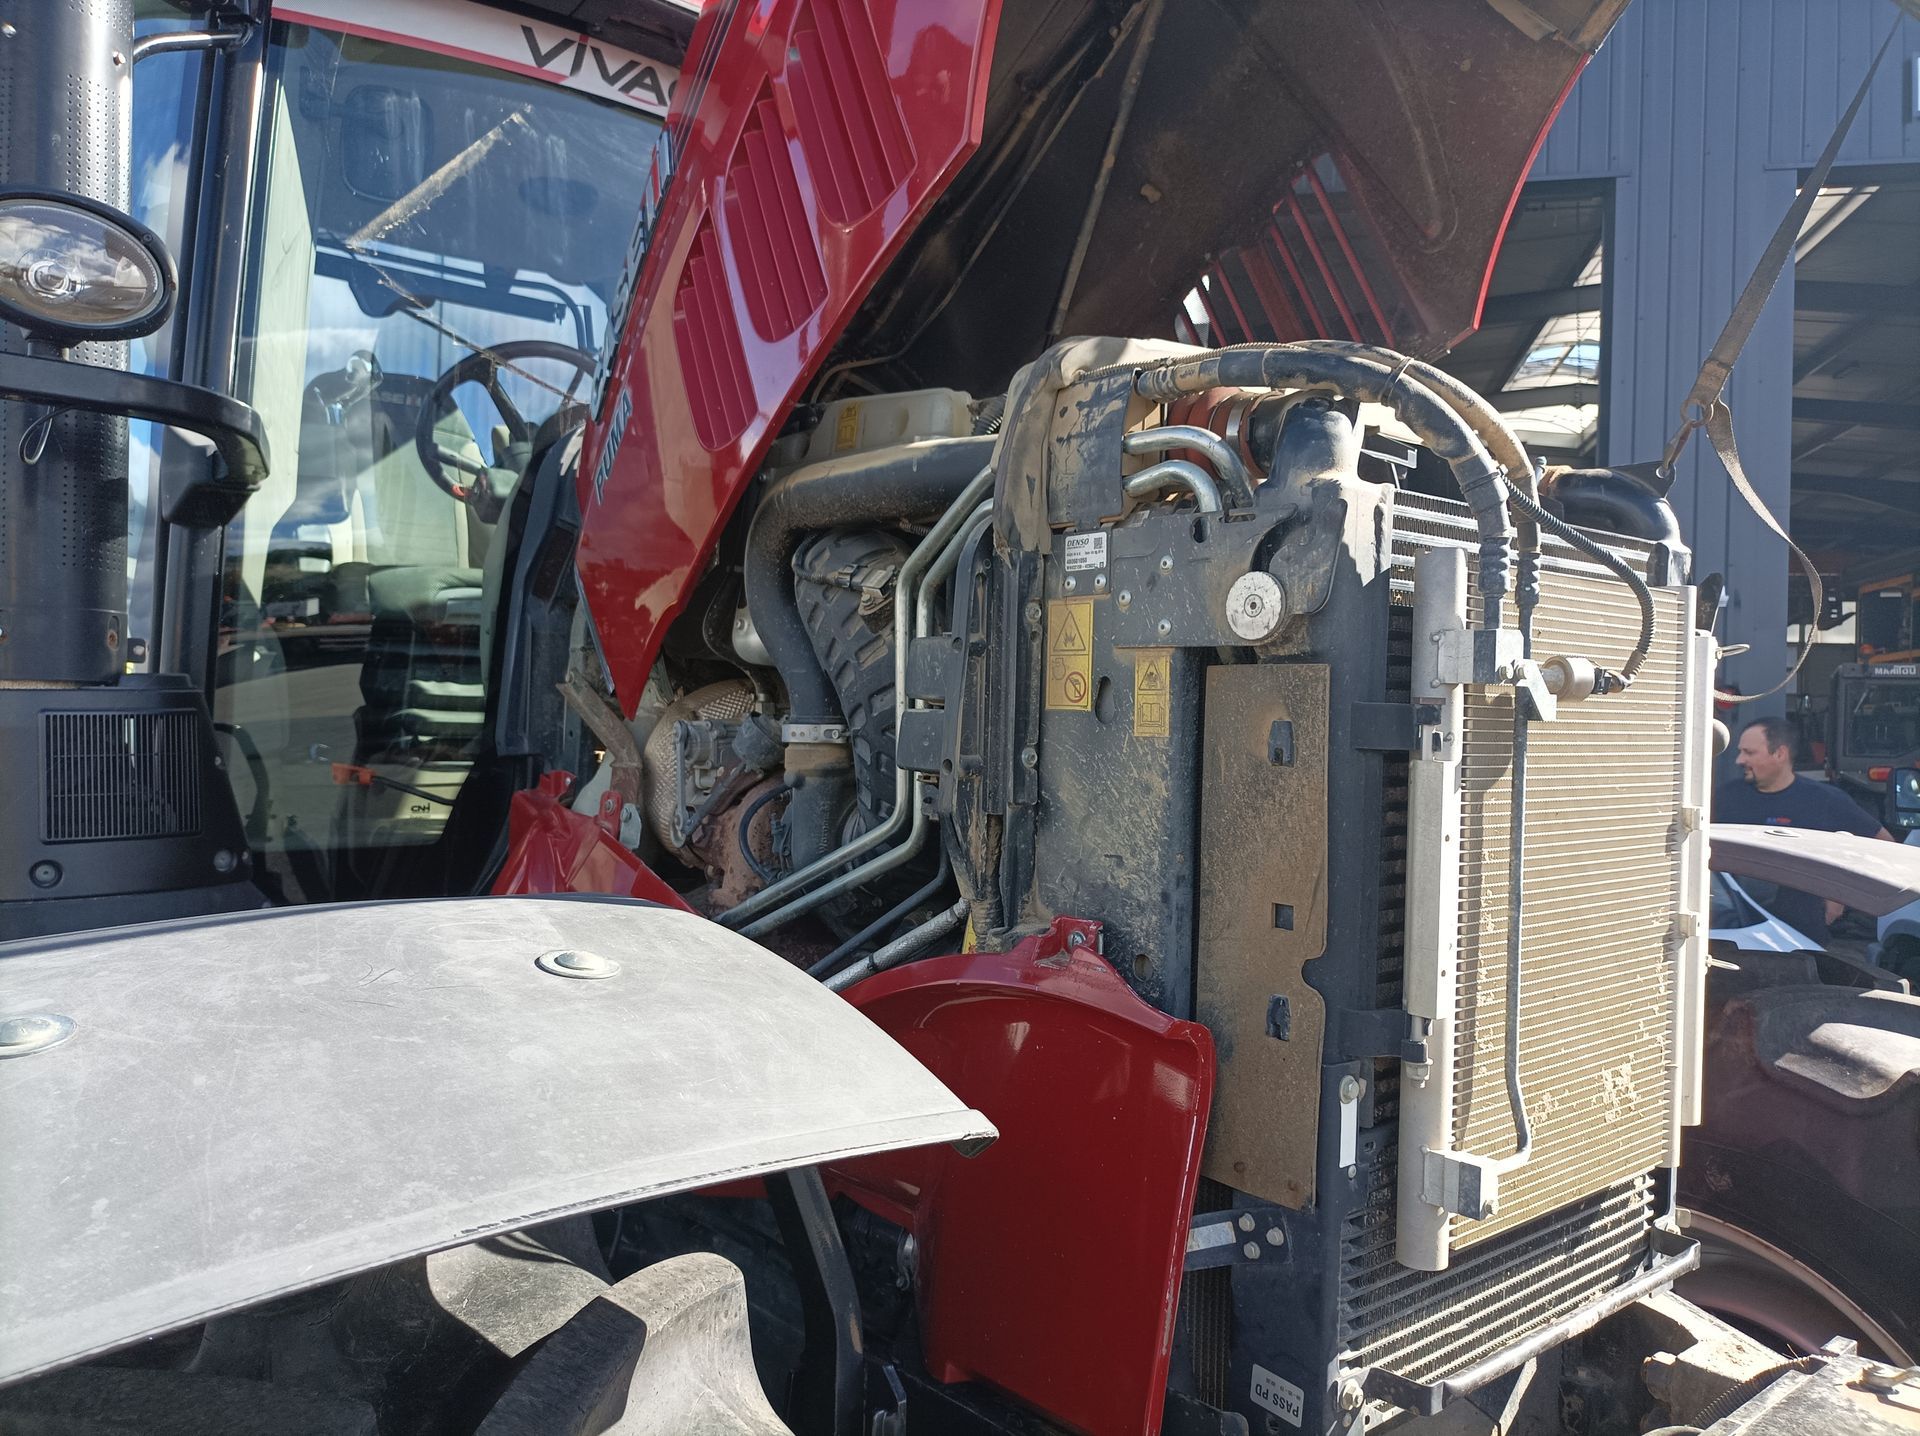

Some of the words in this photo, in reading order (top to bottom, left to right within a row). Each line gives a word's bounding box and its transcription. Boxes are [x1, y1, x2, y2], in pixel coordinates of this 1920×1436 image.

[595, 387, 633, 505] PUMA
[1067, 538, 1090, 546] DENSO
[1255, 1383, 1269, 1401] PD
[1272, 1393, 1299, 1418] PASS
